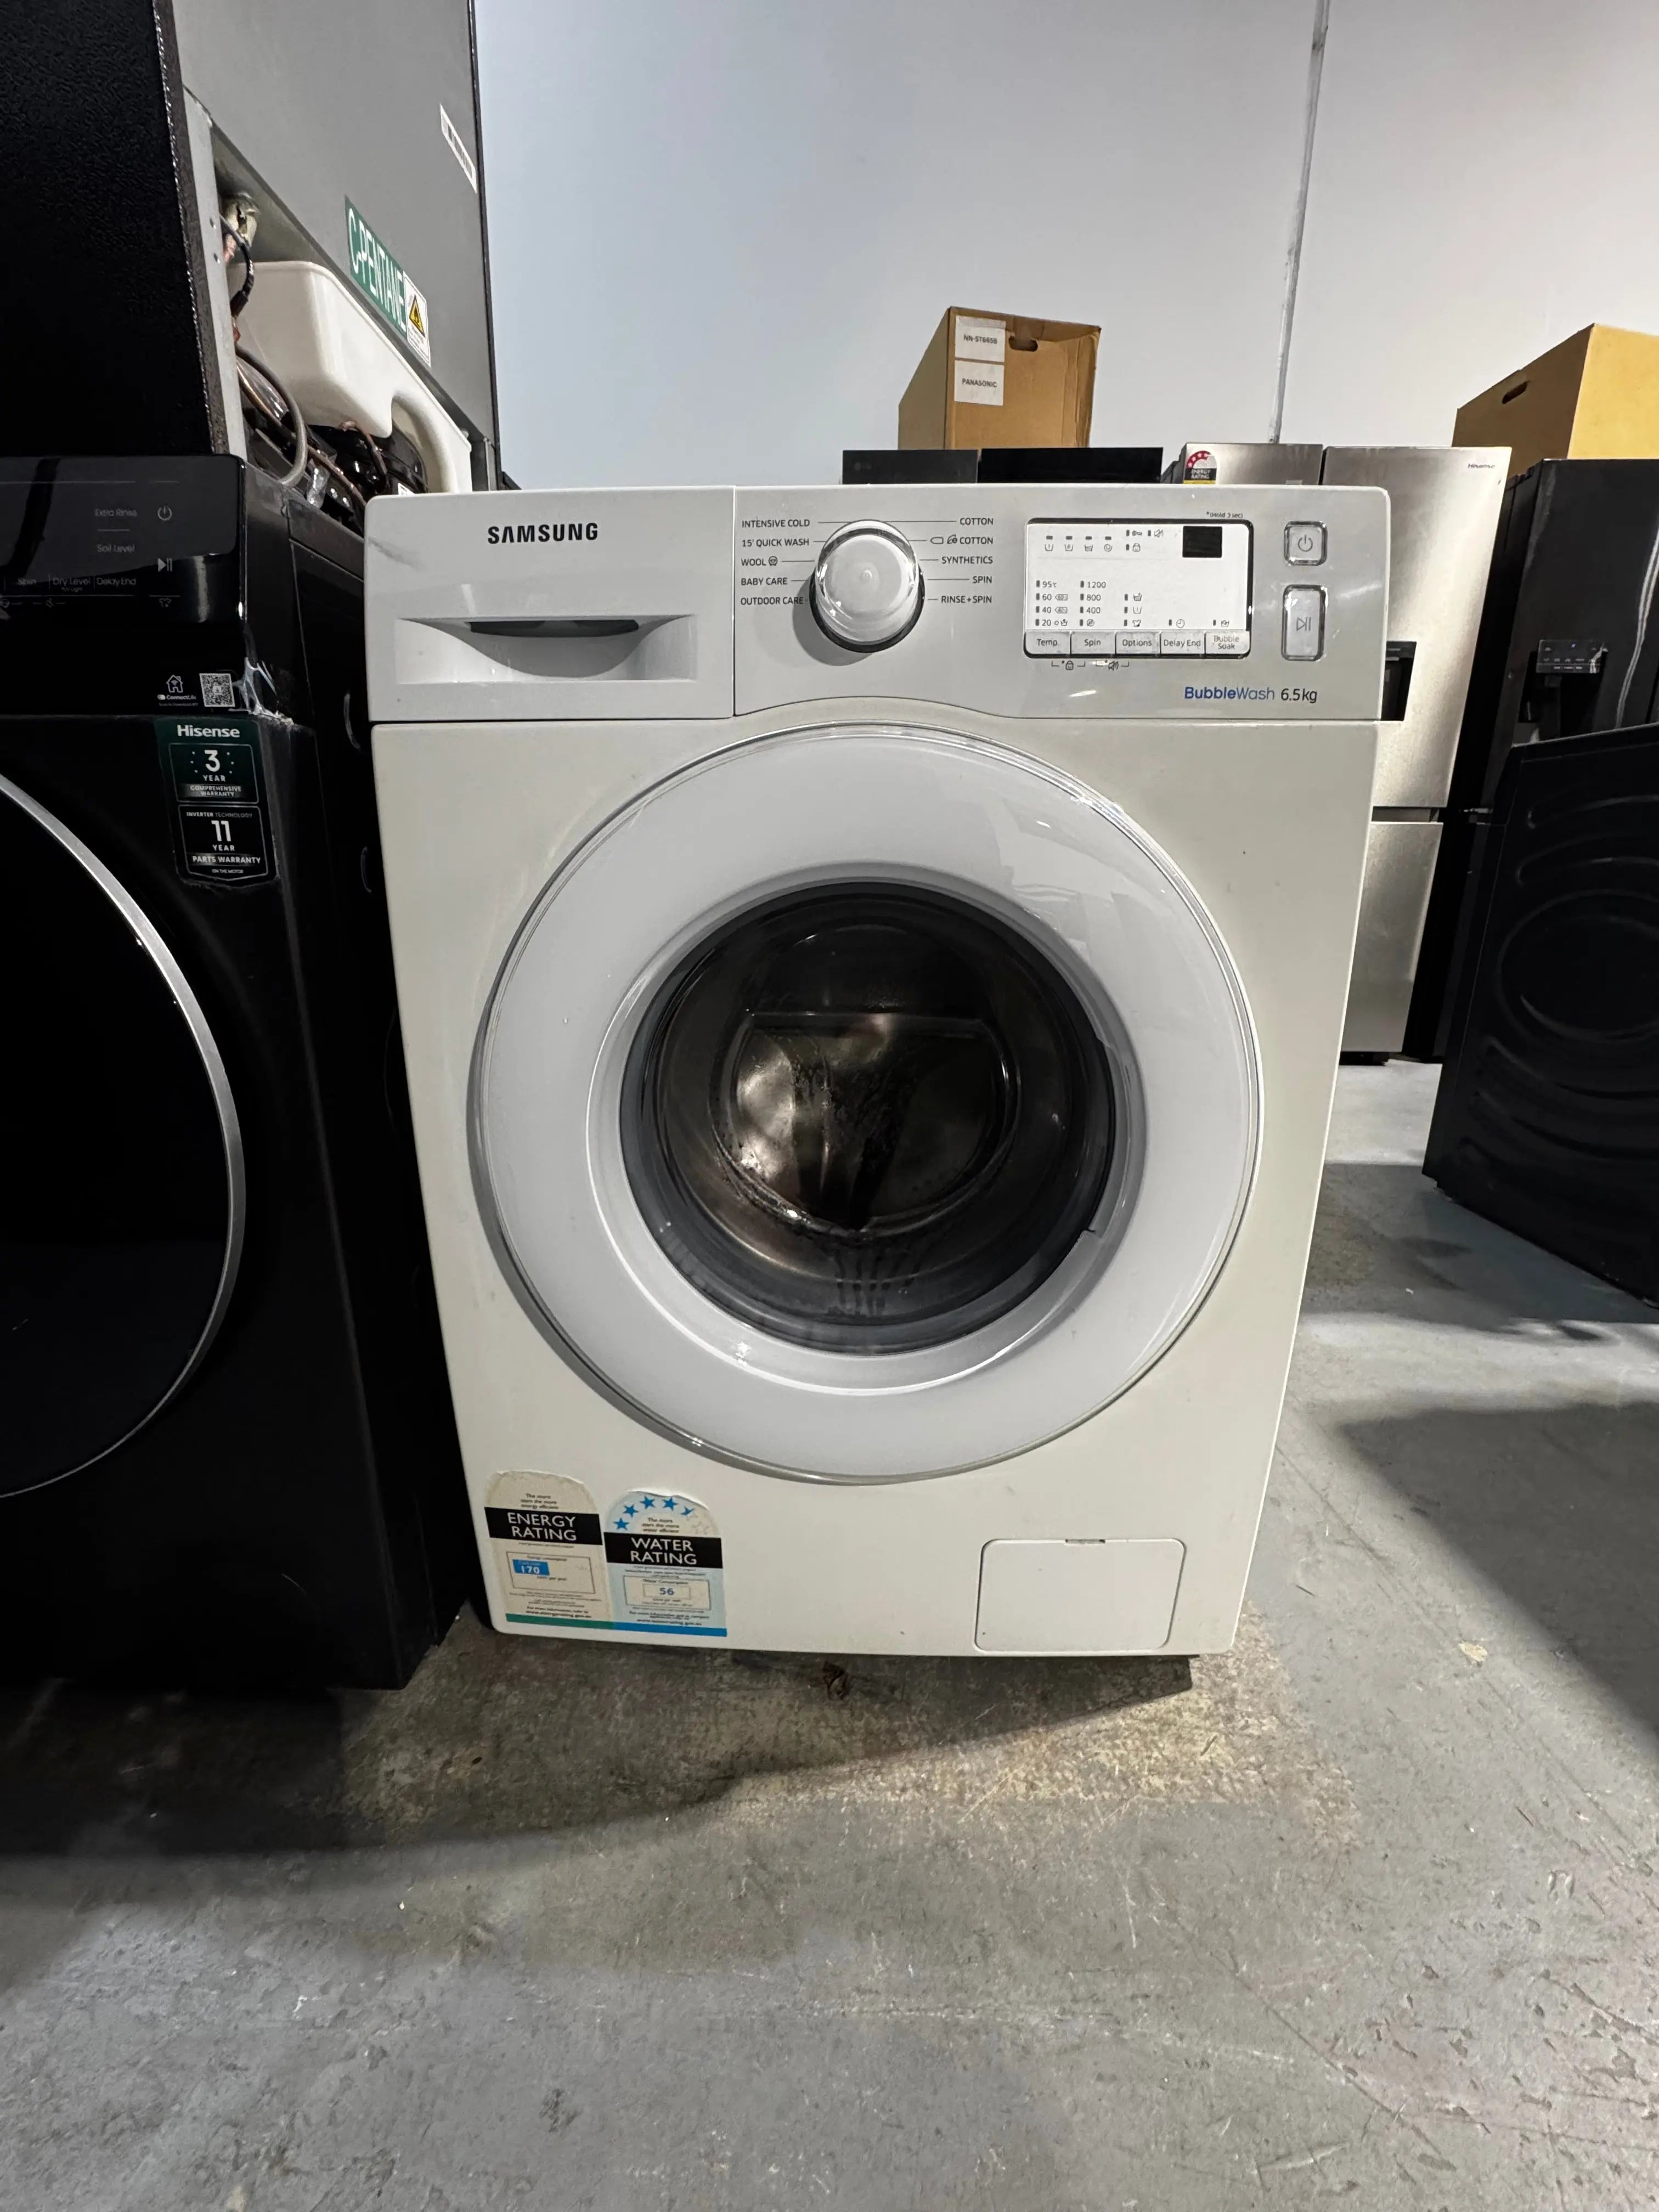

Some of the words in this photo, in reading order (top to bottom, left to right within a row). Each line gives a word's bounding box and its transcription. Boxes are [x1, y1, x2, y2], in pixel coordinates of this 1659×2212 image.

[348, 207, 407, 333] C-PENTANE
[962, 377, 998, 388] PANASONIC
[94, 508, 114, 517] Extra
[115, 508, 138, 517] Rinse
[742, 519, 786, 528] INTENSIVE
[787, 519, 810, 527] COLD
[960, 517, 994, 526] COTTON
[487, 522, 598, 545] SAMSUNG
[756, 539, 782, 548] QUICK
[784, 538, 810, 546] WASH
[960, 537, 994, 545] COTTON
[97, 544, 111, 553] Soil
[113, 544, 136, 553] Level
[741, 558, 767, 567] WOOL
[941, 556, 994, 565] SYNTHETICS
[52, 577, 67, 587] Dry
[69, 577, 91, 585] Level
[95, 577, 120, 587] Delay
[120, 577, 137, 586] End
[741, 577, 764, 586] BABY
[766, 577, 788, 585] CARE
[972, 575, 992, 584] SPIN
[740, 597, 781, 605] OUTDOOR
[782, 596, 804, 605] CARE
[1084, 638, 1101, 647] Spin
[1122, 639, 1153, 647] Options
[1164, 639, 1186, 648] Delay
[1186, 639, 1201, 647] End
[1214, 635, 1240, 644] Bubble
[1217, 642, 1235, 650] Soak
[1184, 686, 1276, 701] BubbleWash
[177, 724, 240, 738] Hisense
[204, 749, 221, 772] 3
[211, 820, 232, 842] 11
[212, 844, 235, 852] YEAR
[192, 855, 217, 864] PARTS
[217, 856, 261, 865] WARRANTY
[507, 1511, 576, 1528] ENERGY
[511, 1526, 577, 1542] RATING
[631, 1537, 694, 1552] WATER
[630, 1550, 697, 1565] RATING
[521, 1565, 540, 1575] 170
[659, 1587, 675, 1596] 56
